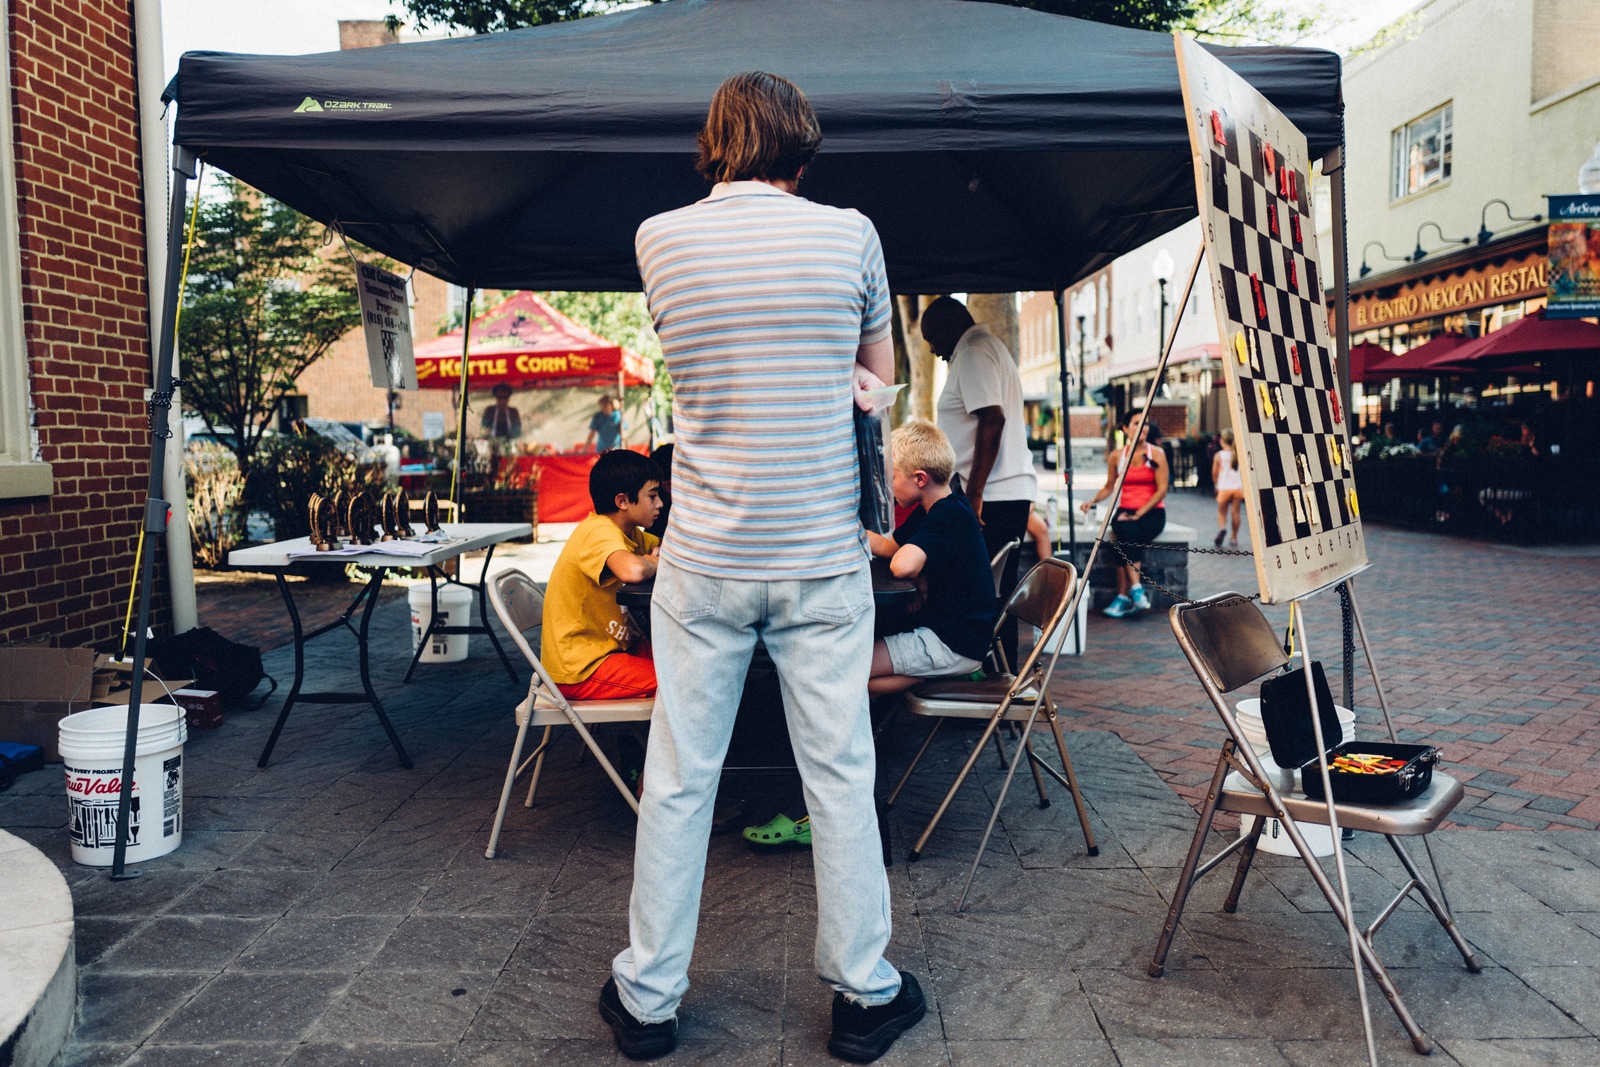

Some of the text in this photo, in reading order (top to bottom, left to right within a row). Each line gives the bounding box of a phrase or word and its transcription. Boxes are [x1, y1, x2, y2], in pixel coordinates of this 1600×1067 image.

[324, 100, 361, 109] OZARK
[1208, 222, 1214, 243] 6
[1217, 279, 1224, 300] 5
[1357, 303, 1368, 326] EL
[1371, 294, 1418, 323] CENTRO
[1421, 279, 1486, 313] MEXICAN
[439, 358, 508, 377] KETTLE
[515, 355, 567, 373] CORN
[1237, 392, 1243, 413] 3
[1275, 554, 1282, 569] a
[1290, 545, 1298, 565] b
[1304, 546, 1311, 560] c
[1317, 534, 1324, 556] d
[1329, 538, 1334, 551] e
[1347, 532, 1352, 549] g
[76, 777, 136, 796] Vale
